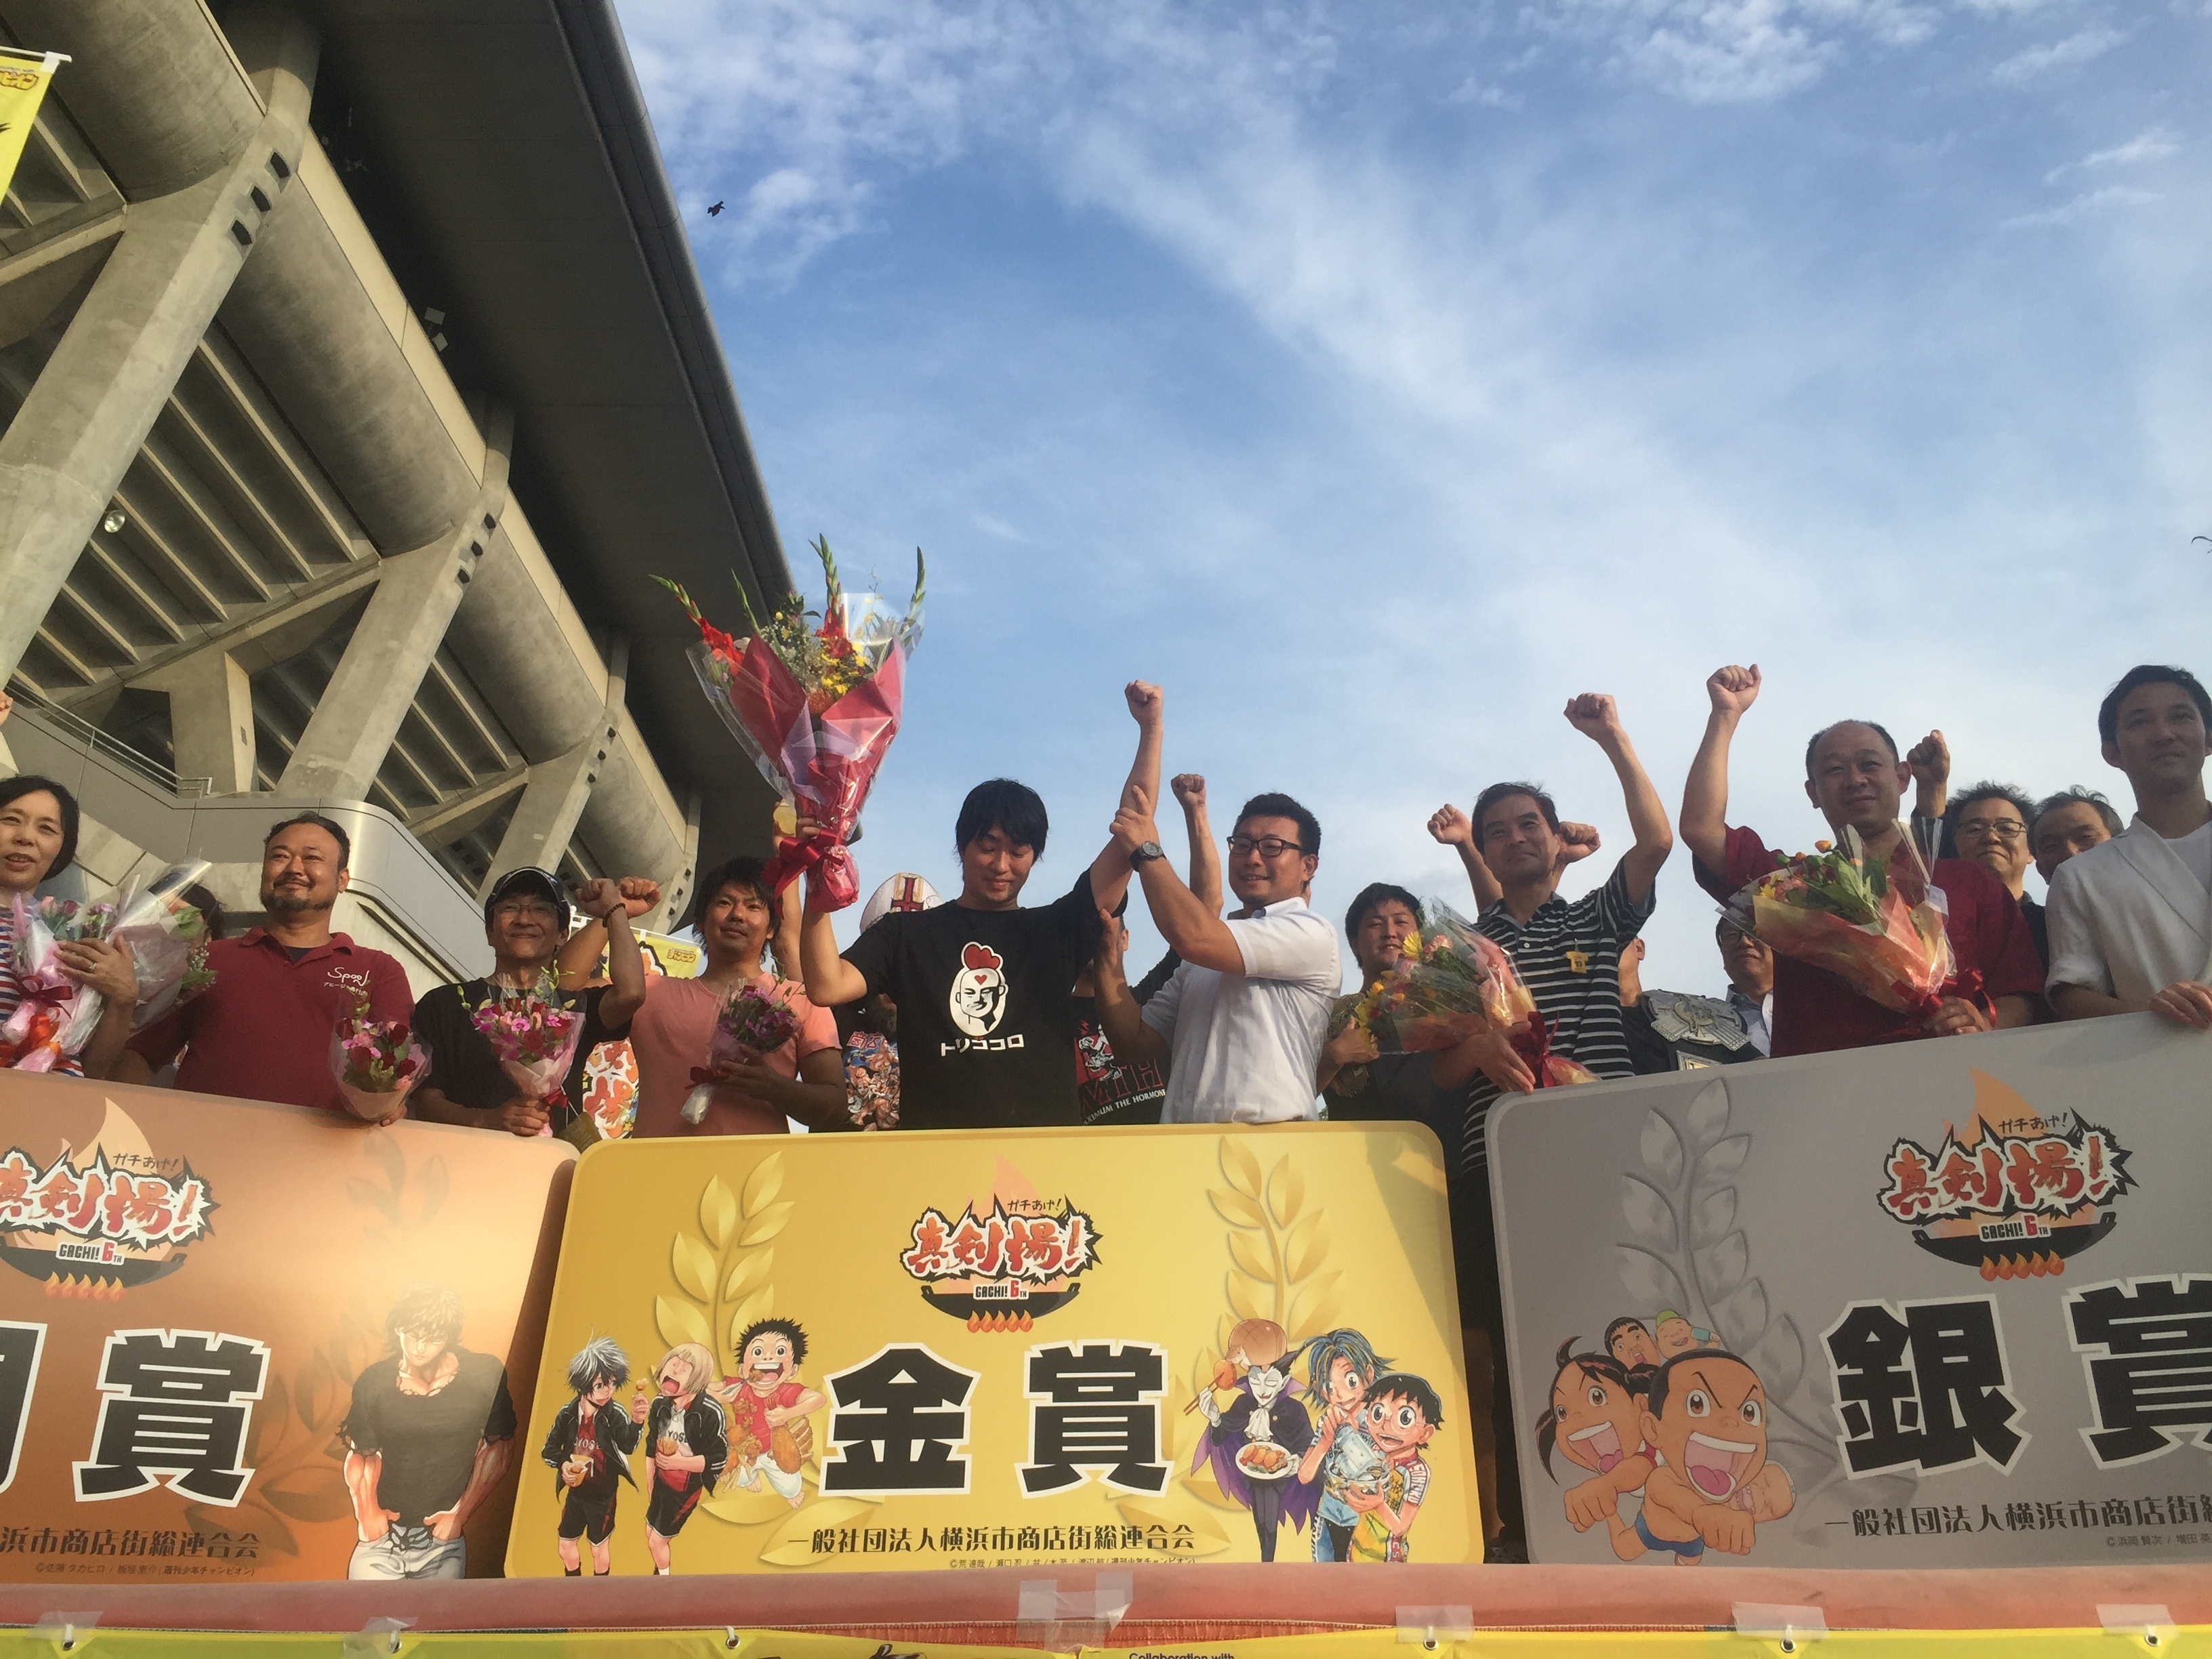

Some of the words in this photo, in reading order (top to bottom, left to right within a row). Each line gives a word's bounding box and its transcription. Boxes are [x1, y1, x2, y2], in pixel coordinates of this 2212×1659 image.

[1114, 1098, 1131, 1109] THE
[1981, 1225, 2023, 1240] GACHI!
[58, 1244, 100, 1261] GACHI!
[975, 1284, 1008, 1298] GACHI!
[1819, 1273, 2212, 1480] 銀賞
[818, 1338, 1175, 1499] 金賞
[787, 1524, 1195, 1555] 一般社団法人横浜市商店街総連合会
